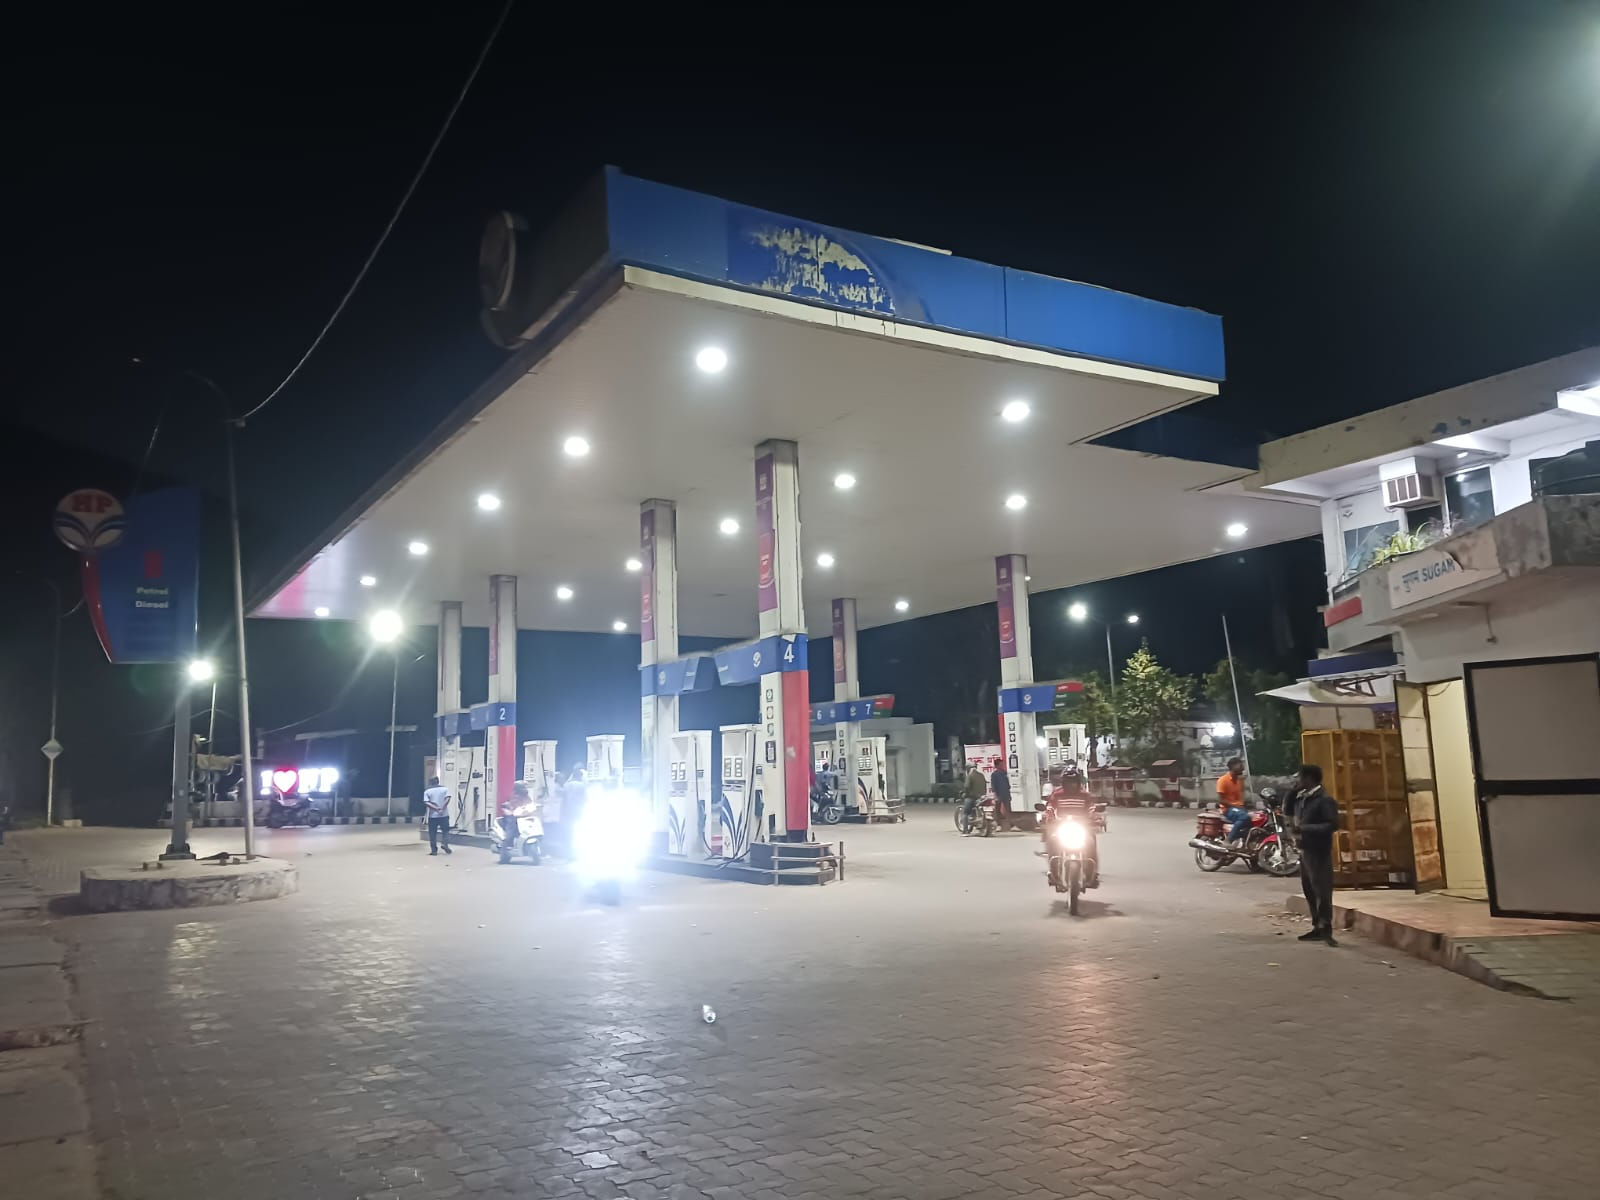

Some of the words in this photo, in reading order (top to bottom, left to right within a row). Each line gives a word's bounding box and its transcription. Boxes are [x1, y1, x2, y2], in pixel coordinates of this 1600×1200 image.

[72, 493, 113, 513] HP
[1422, 559, 1455, 581] SUGAM
[783, 644, 795, 663] 4
[499, 708, 506, 720] 2
[817, 710, 823, 720] 6
[865, 704, 871, 715] 7
